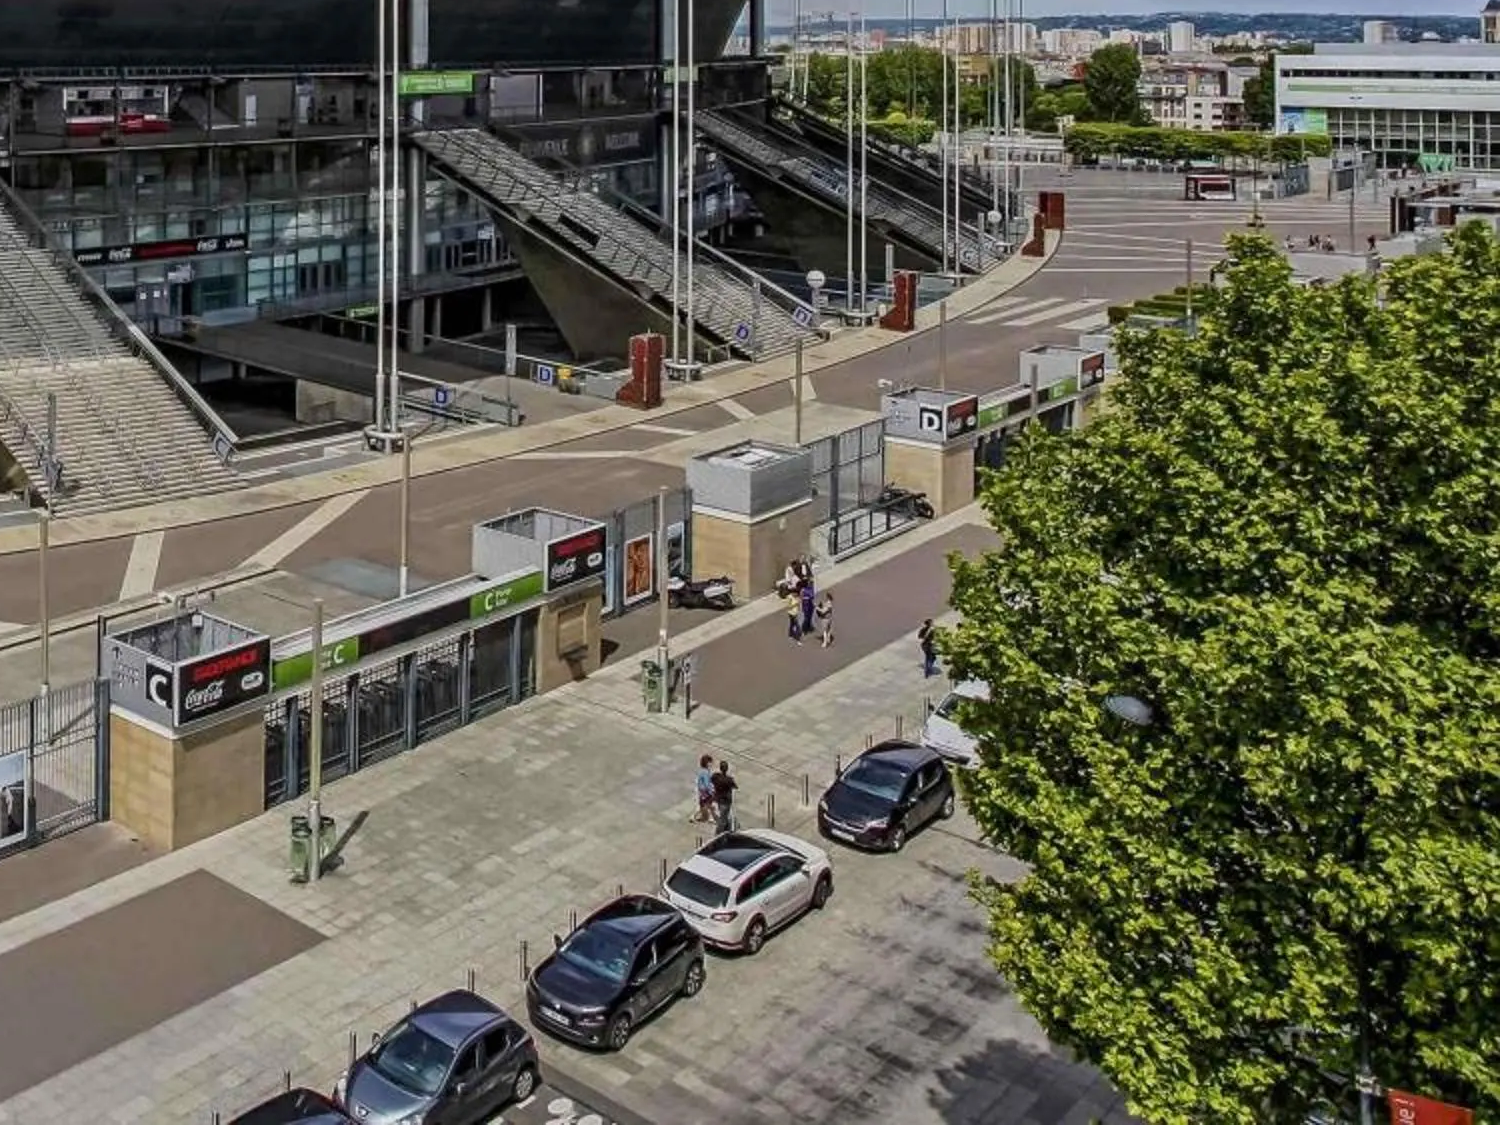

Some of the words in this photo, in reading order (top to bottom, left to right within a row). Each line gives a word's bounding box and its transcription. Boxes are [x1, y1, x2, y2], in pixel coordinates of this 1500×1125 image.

[921, 411, 940, 430] D
[485, 592, 494, 611] C
[333, 644, 345, 664] C
[149, 674, 168, 706] C
